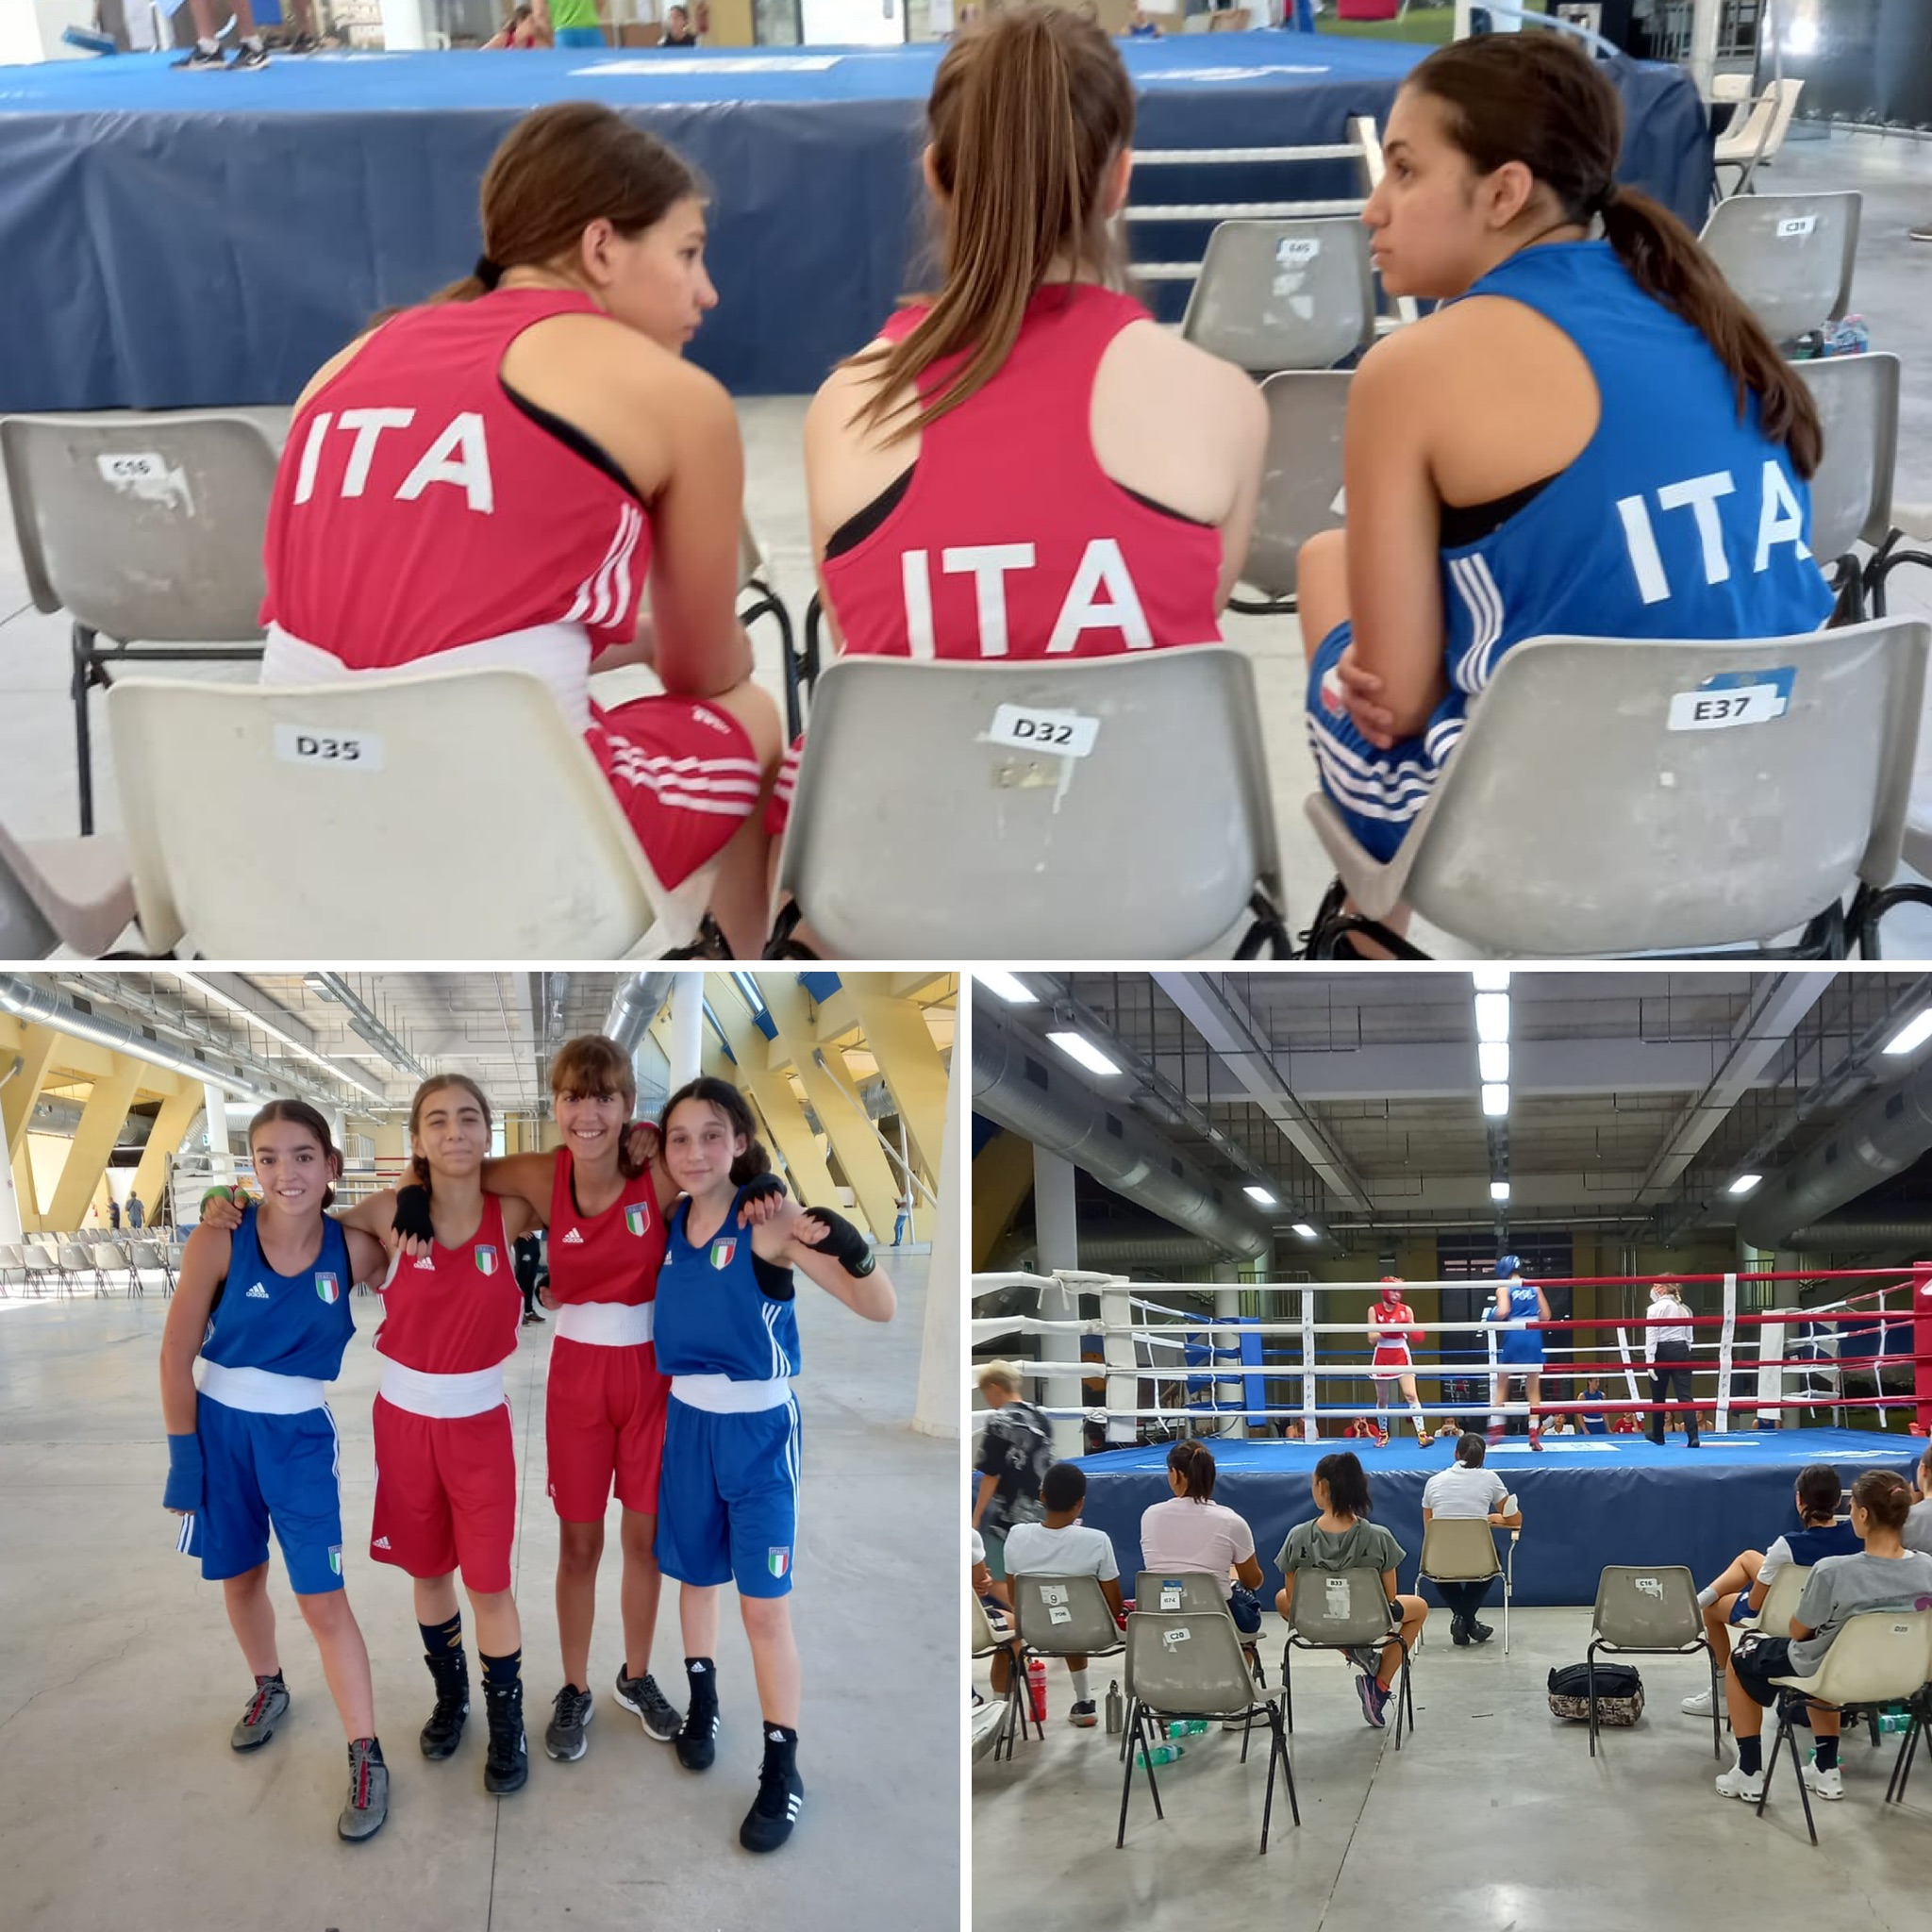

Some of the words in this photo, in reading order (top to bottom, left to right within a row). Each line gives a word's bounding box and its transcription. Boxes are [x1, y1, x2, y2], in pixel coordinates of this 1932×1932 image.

[293, 408, 494, 514] ITA
[1616, 459, 1812, 605] ITA
[902, 539, 1154, 660] ITA
[1693, 697, 1751, 722] E37
[1013, 718, 1074, 746] D32
[296, 737, 360, 760] D35
[1170, 1632, 1185, 1641] C20
